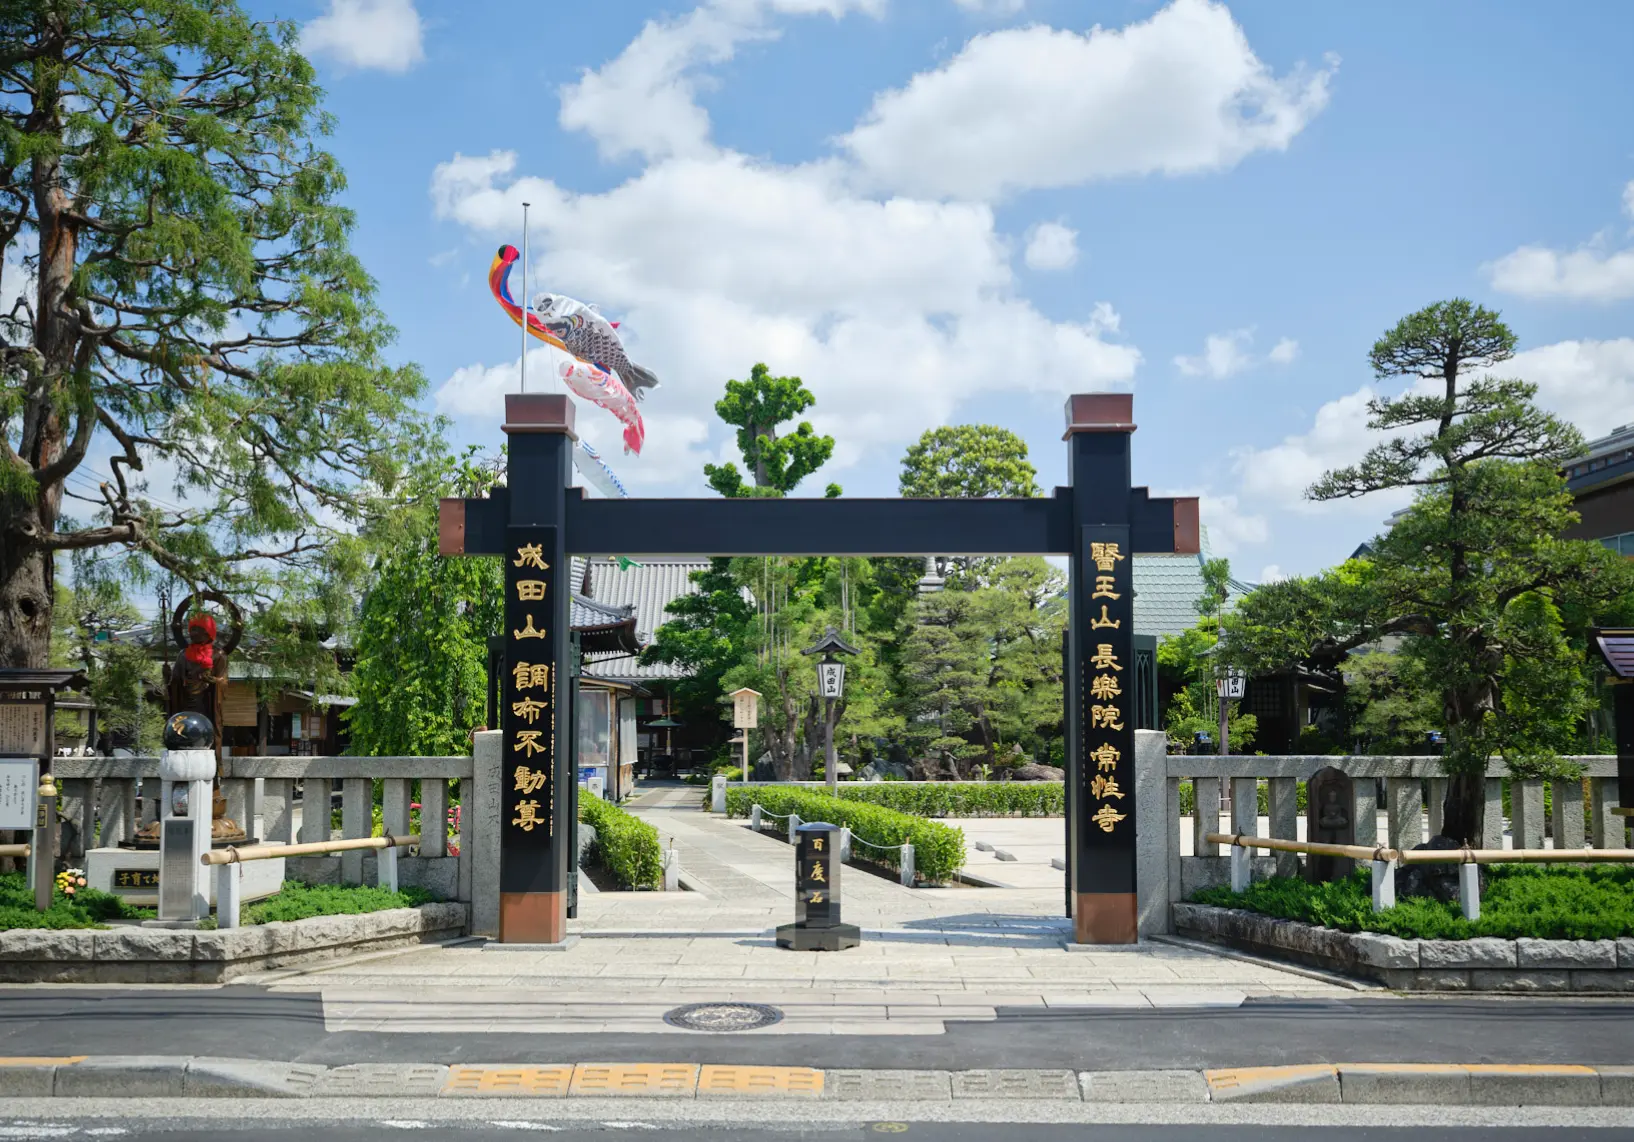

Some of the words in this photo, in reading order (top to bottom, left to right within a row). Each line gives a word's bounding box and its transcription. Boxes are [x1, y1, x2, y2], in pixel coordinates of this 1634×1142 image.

[1231, 672, 1239, 694] 田山
[810, 838, 826, 903] 百度石
